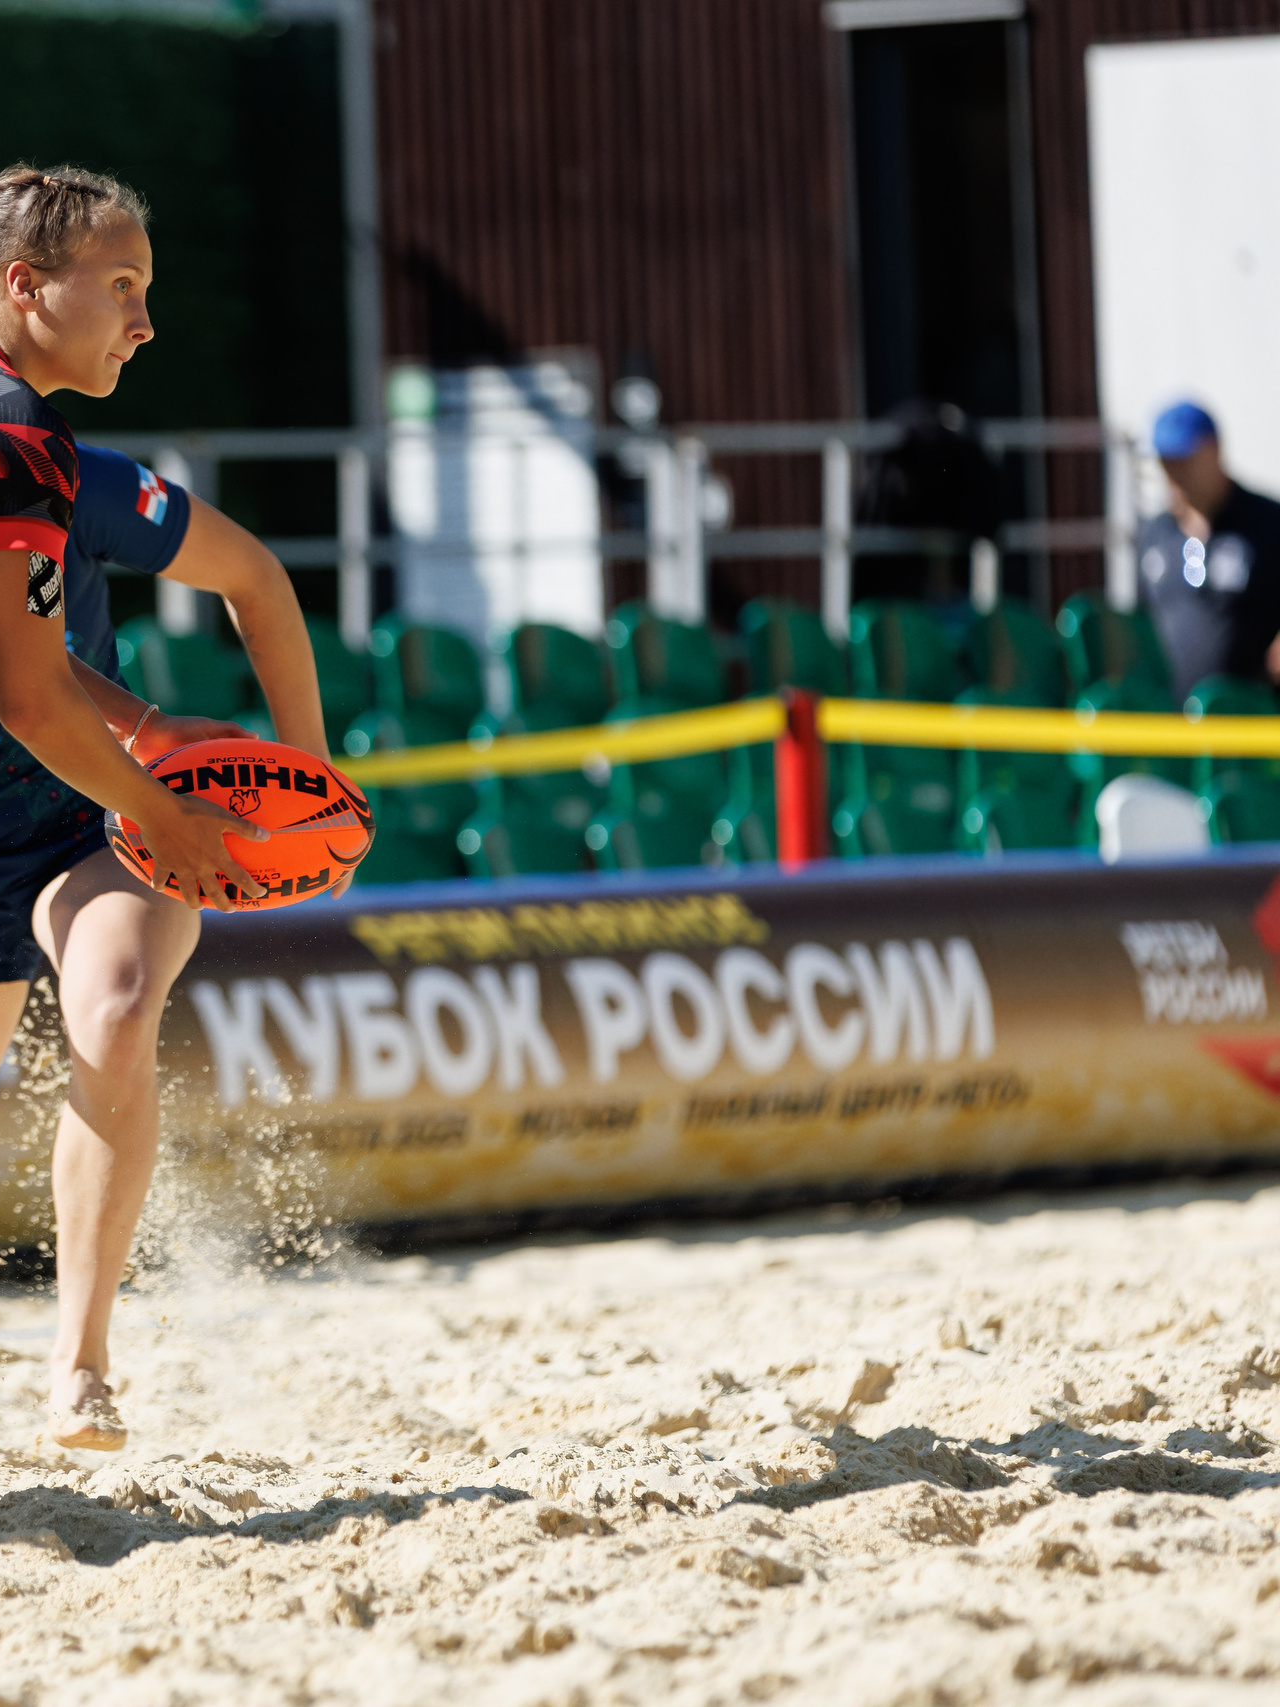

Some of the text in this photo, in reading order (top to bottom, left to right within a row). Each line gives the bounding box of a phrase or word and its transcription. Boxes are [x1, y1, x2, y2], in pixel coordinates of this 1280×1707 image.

[191, 937, 996, 1107] КУБОК РОССИИ
[1142, 967, 1268, 1025] РОССИИ
